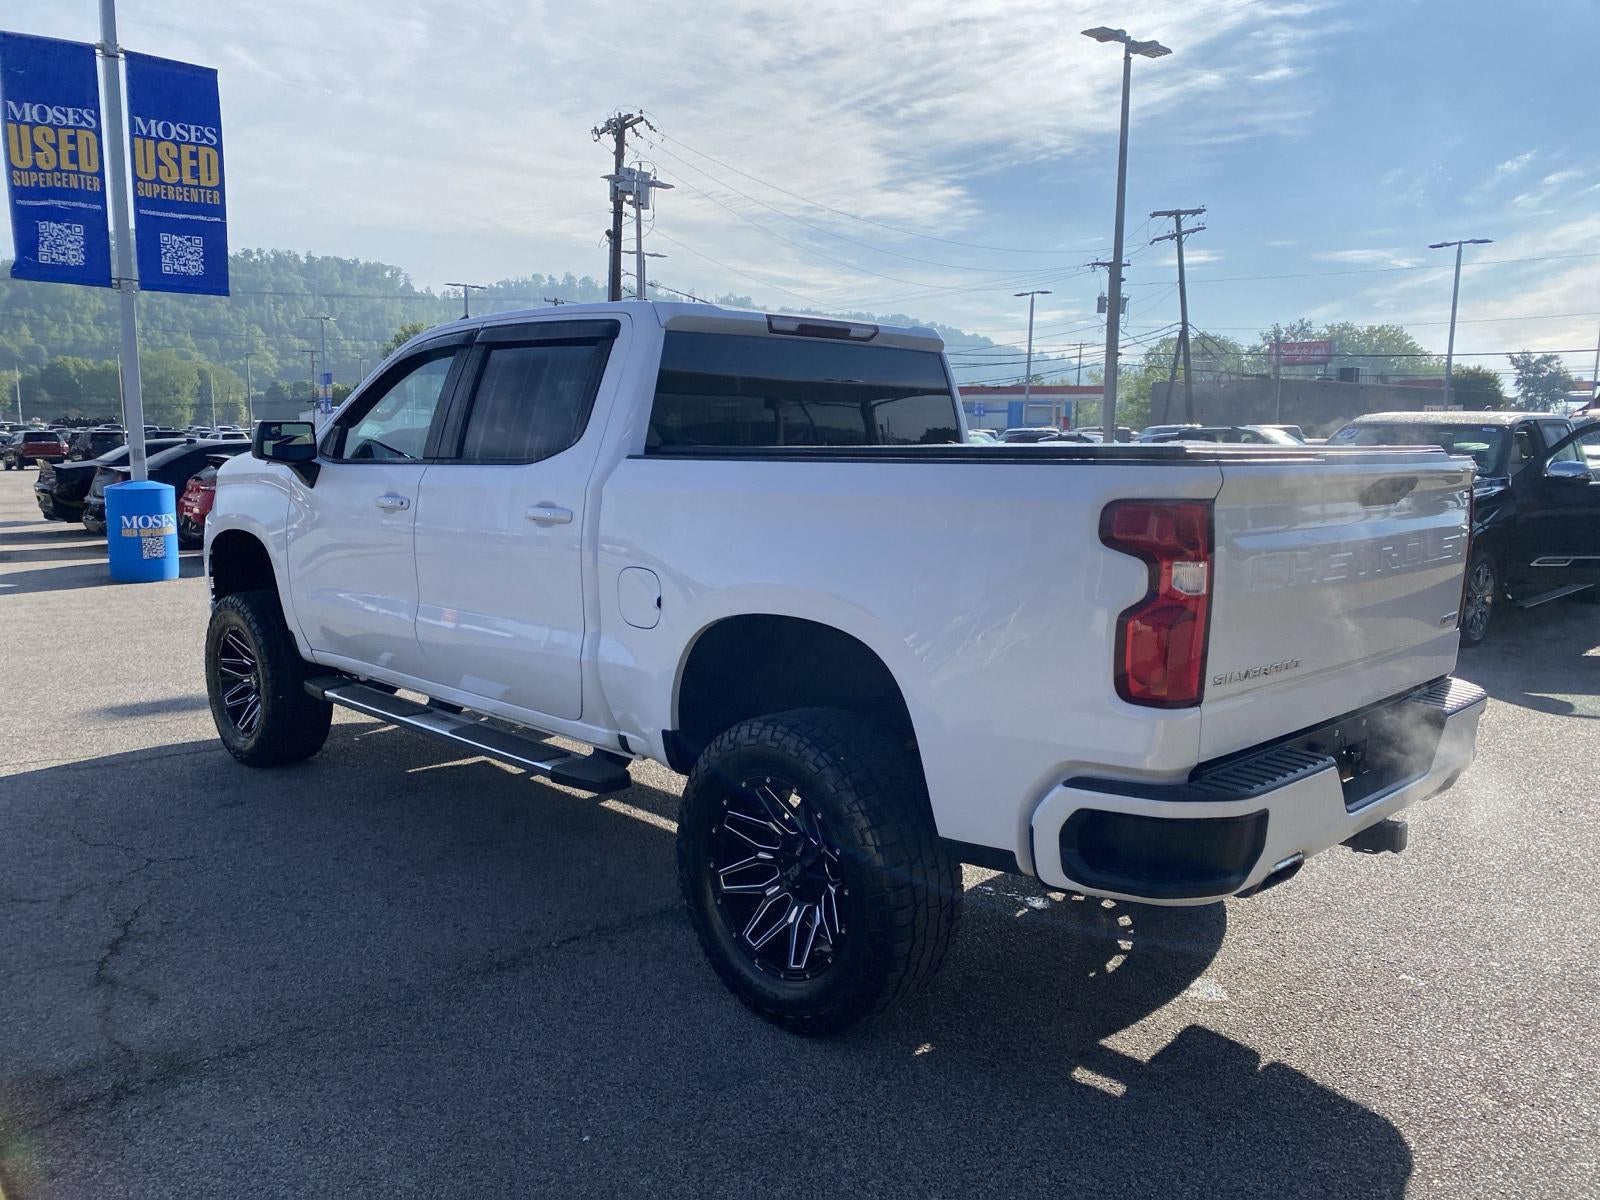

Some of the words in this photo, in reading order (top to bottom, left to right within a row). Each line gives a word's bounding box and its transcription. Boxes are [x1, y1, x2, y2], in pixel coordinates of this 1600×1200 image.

[7, 100, 97, 129] MOSES
[133, 116, 218, 145] MOSES
[7, 122, 100, 173] USED
[134, 137, 220, 187] USED
[13, 170, 101, 192] SUPERCENTER
[137, 183, 220, 205] SUPERCENTER
[1244, 531, 1467, 592] CHEVROLE
